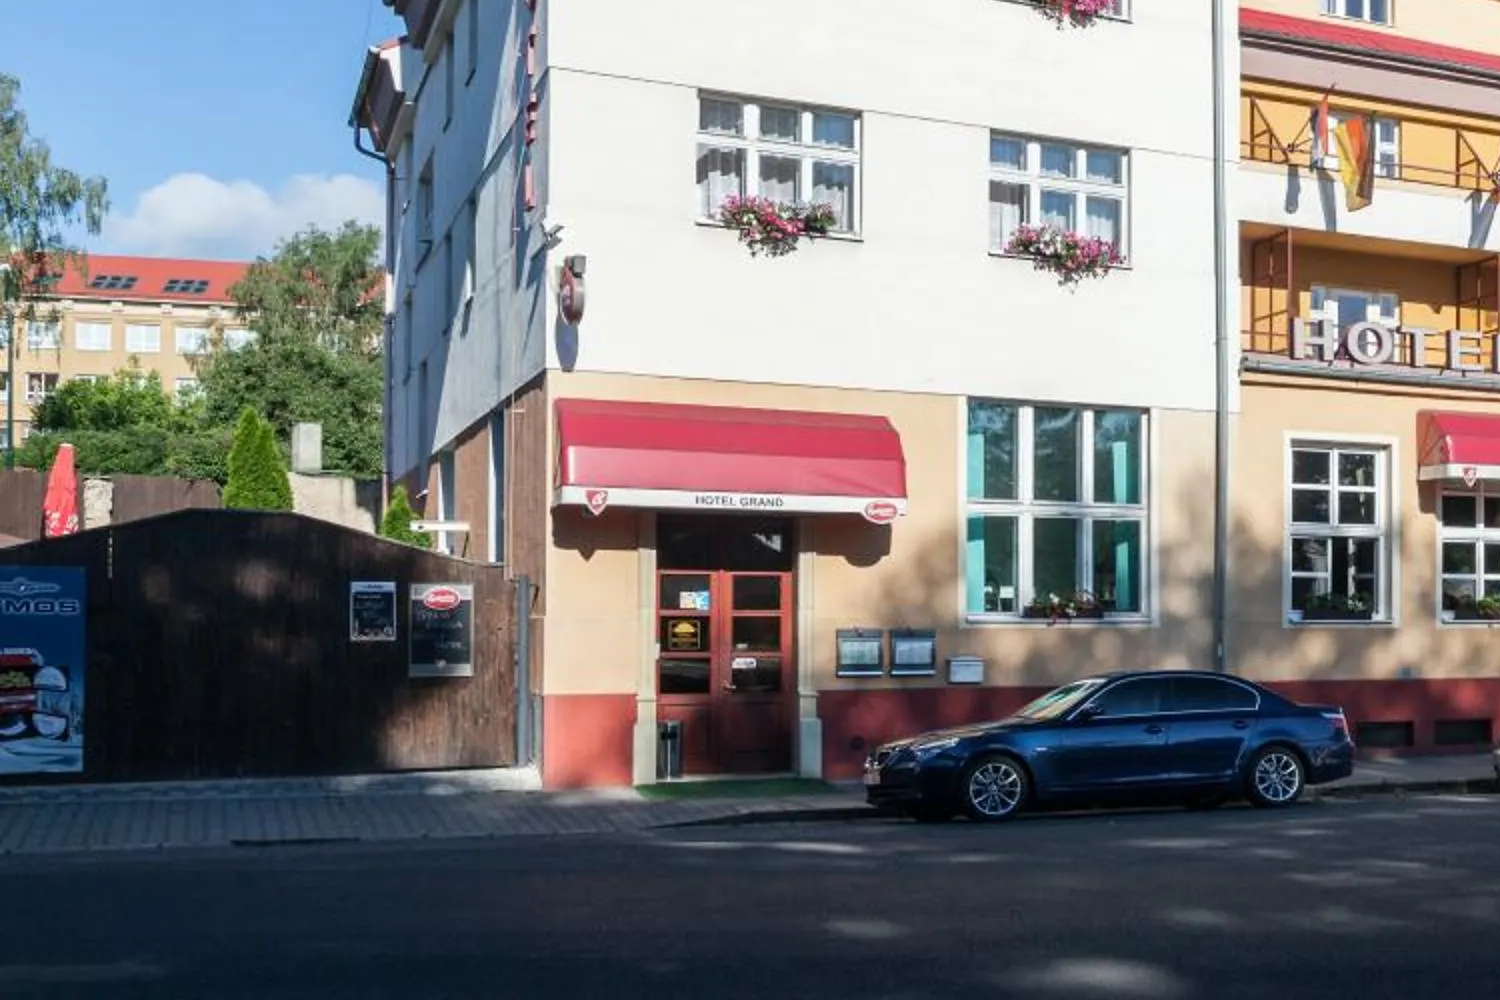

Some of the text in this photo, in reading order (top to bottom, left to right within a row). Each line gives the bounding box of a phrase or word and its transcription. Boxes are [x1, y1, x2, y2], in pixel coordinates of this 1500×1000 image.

[695, 495, 784, 507] HOTEL GRAND
[0, 597, 80, 616] MOS
